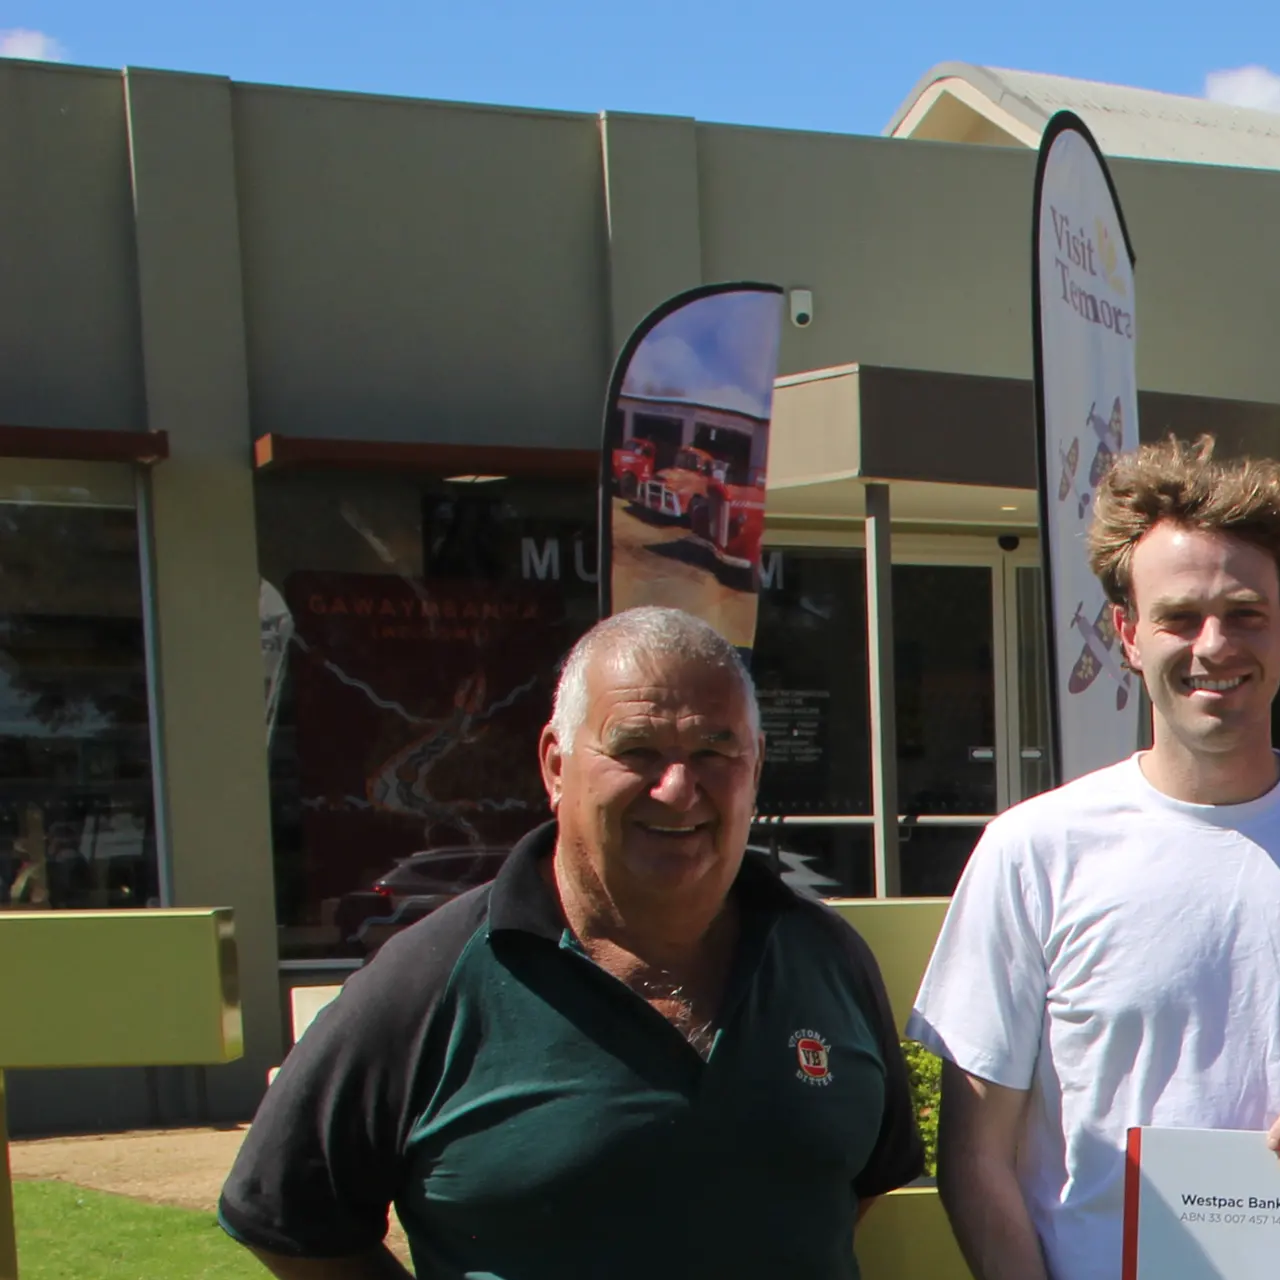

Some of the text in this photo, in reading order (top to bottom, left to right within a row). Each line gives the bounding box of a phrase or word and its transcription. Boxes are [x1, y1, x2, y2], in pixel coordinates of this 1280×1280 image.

[1050, 205, 1097, 276] Visit
[1055, 257, 1132, 339] Temora
[1180, 1212, 1206, 1222] ABN
[1208, 1213, 1221, 1223] 33
[1224, 1213, 1246, 1224] 007
[1249, 1215, 1268, 1225] 457
[1181, 1194, 1243, 1209] Westpac
